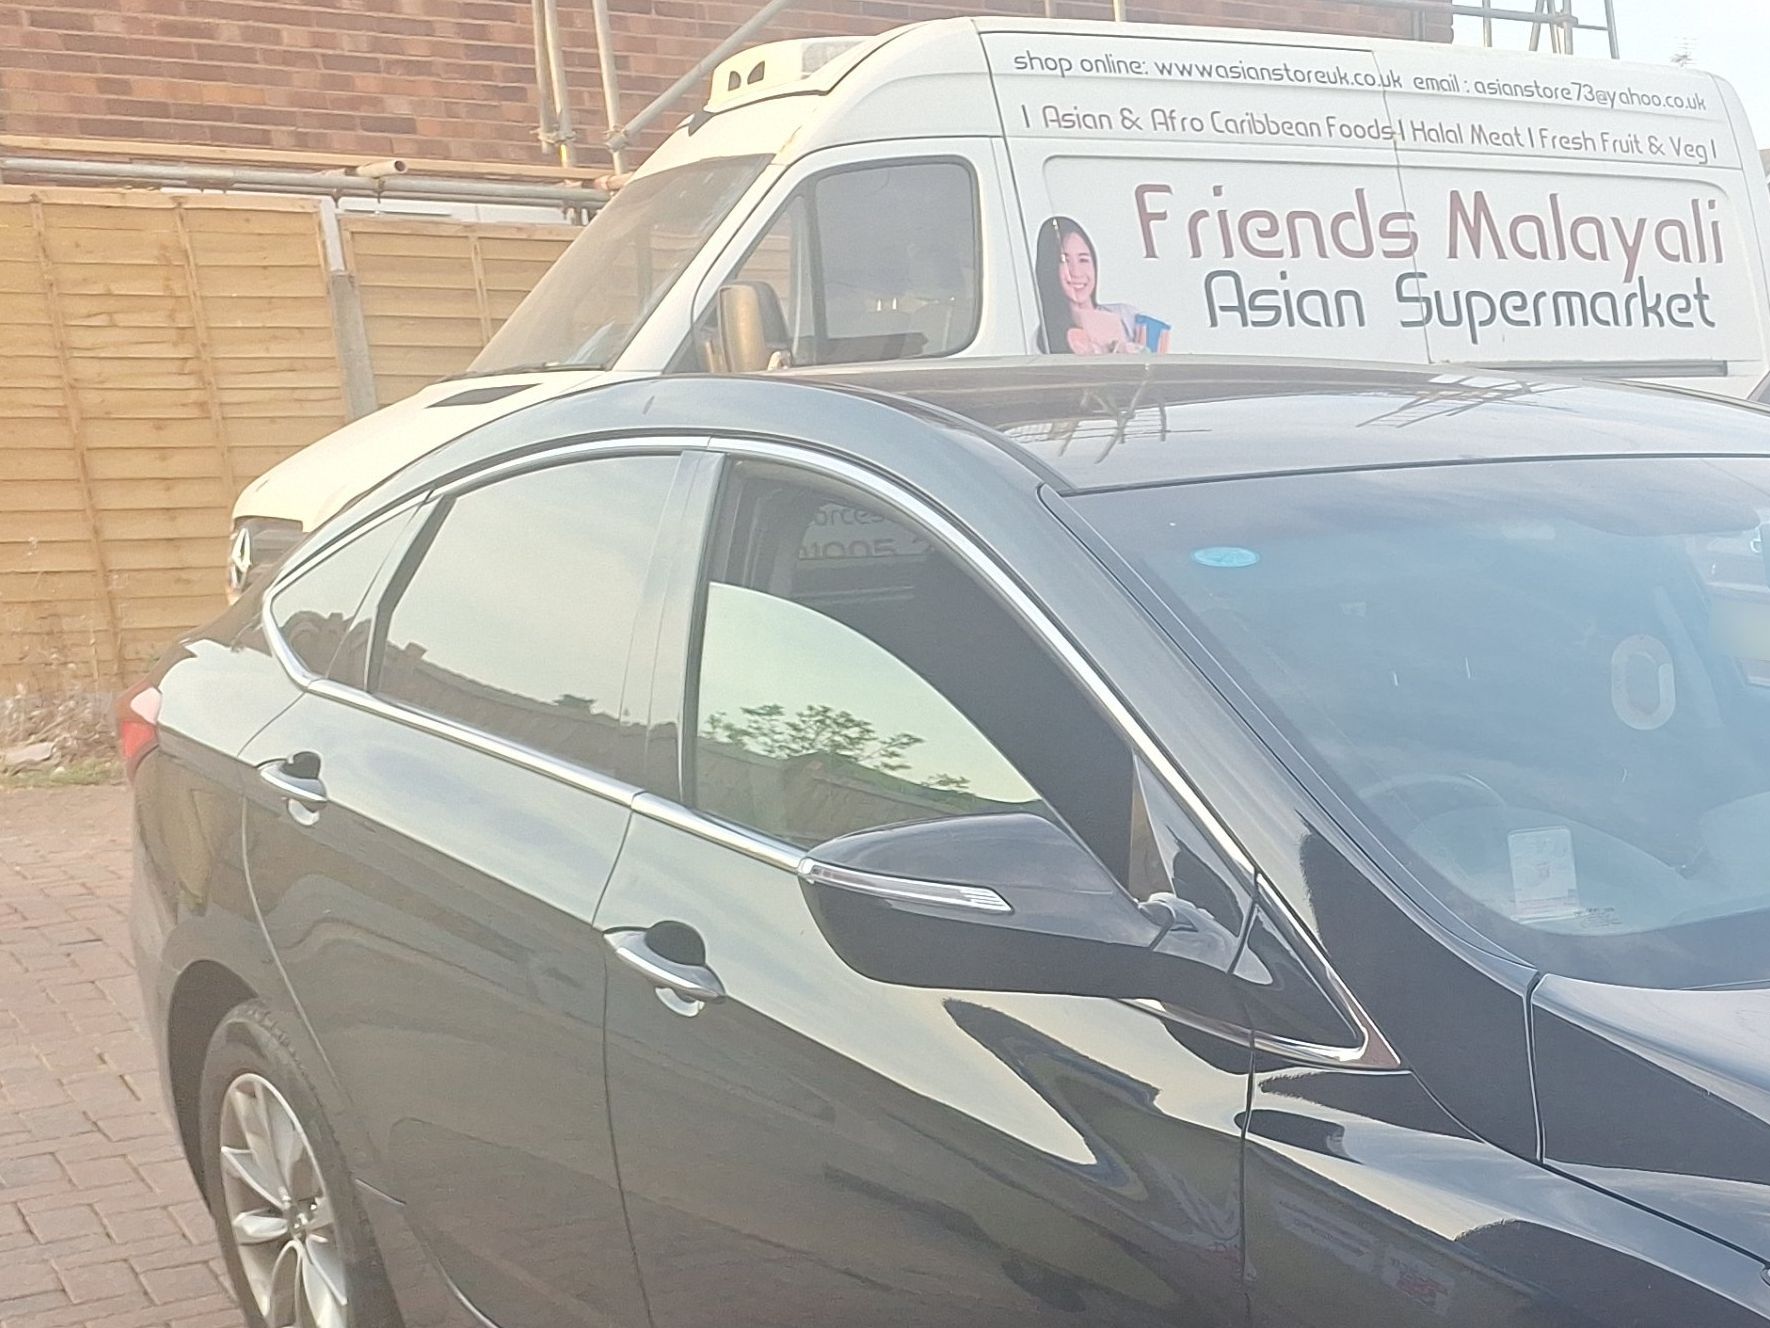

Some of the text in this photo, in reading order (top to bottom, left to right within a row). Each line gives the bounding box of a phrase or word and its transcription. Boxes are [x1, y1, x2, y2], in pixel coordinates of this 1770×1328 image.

[1014, 50, 1072, 77] shop
[1080, 54, 1149, 75] online:
[1474, 79, 1707, 111] asianstore73@yahoo.co.uk
[1042, 105, 1113, 130] Asian
[1120, 108, 1143, 131] &
[1151, 108, 1204, 132] Afro
[1210, 111, 1322, 138] Caribbean
[1326, 115, 1395, 140] Foods
[1412, 120, 1464, 144] Halal
[1470, 123, 1523, 148] Meat
[1539, 128, 1597, 152] Fresh
[1600, 132, 1643, 155] Fruit
[1648, 135, 1666, 157] &
[1669, 137, 1708, 165] Veg
[1134, 183, 1725, 284] Friends Malayali
[1204, 269, 1716, 345] Asian Supermarket
